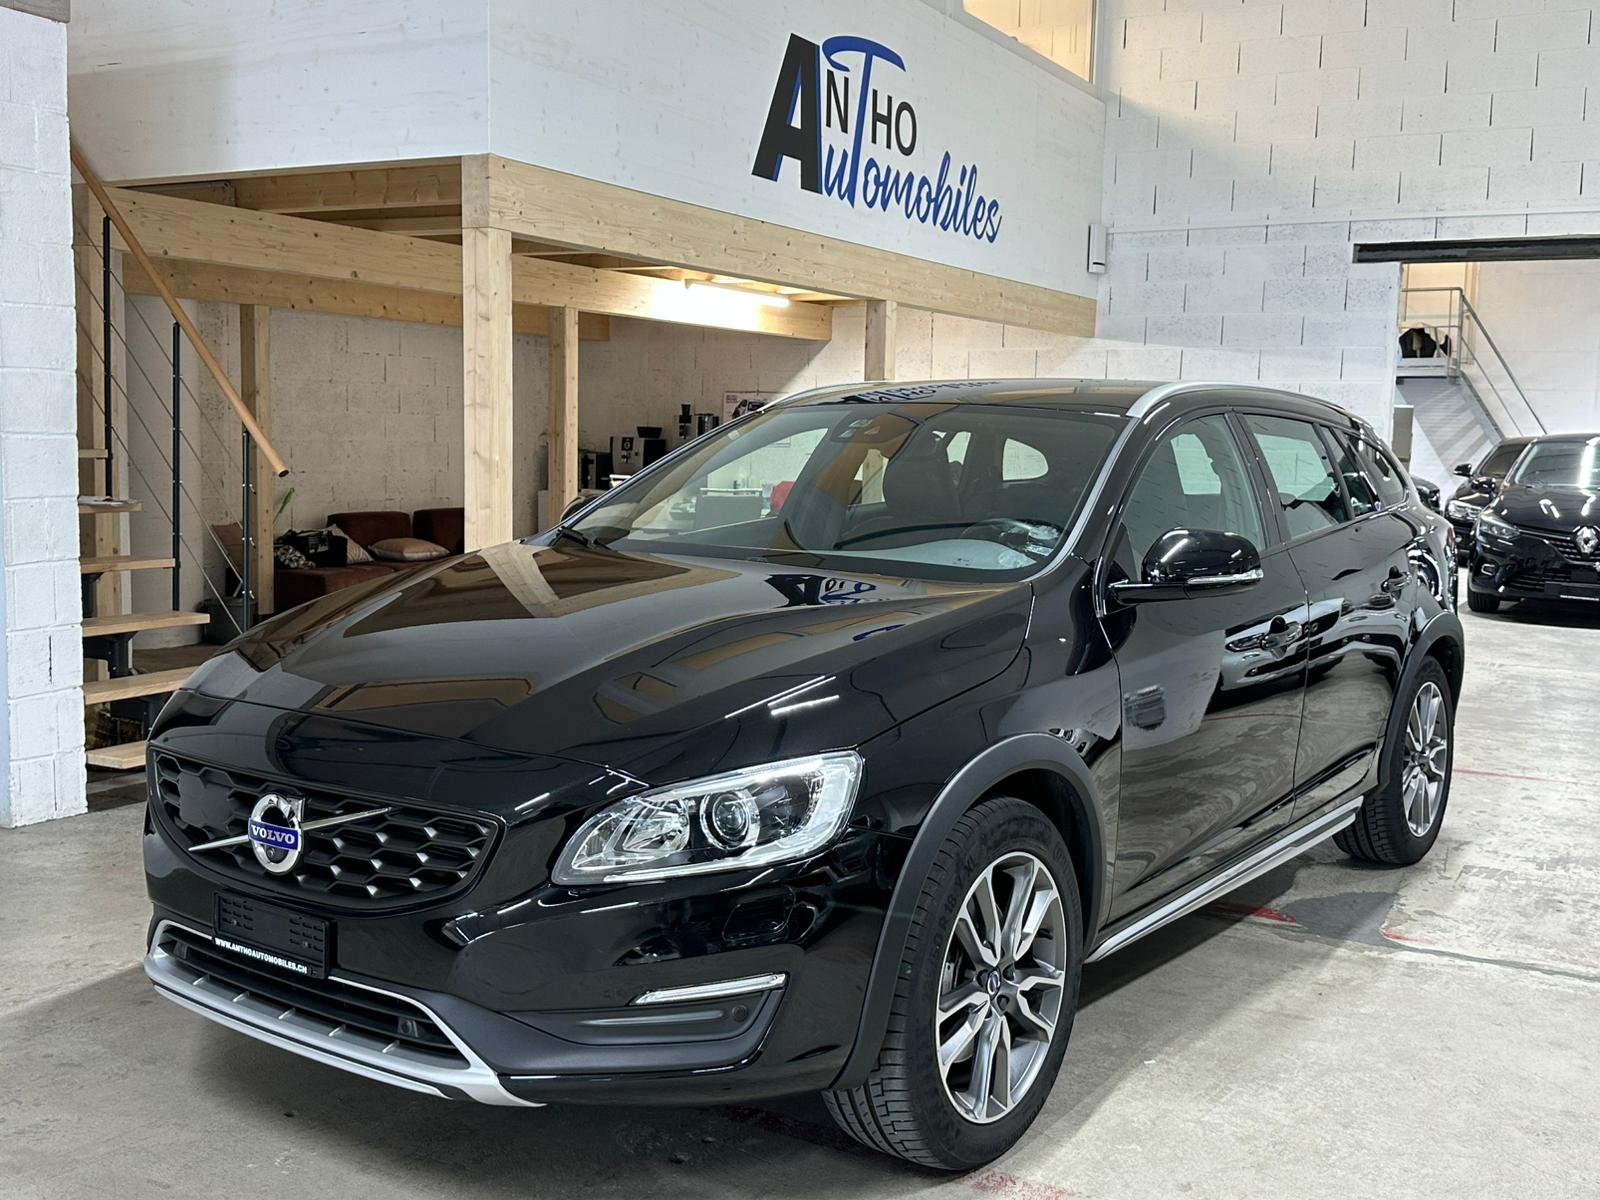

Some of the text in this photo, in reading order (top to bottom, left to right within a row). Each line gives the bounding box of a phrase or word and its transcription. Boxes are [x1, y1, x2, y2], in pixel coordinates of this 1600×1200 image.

[752, 33, 917, 203] ANTHO
[251, 824, 295, 844] VOLVO
[214, 937, 308, 974] WWW.ANTHOAUTOMOBILES.CH
